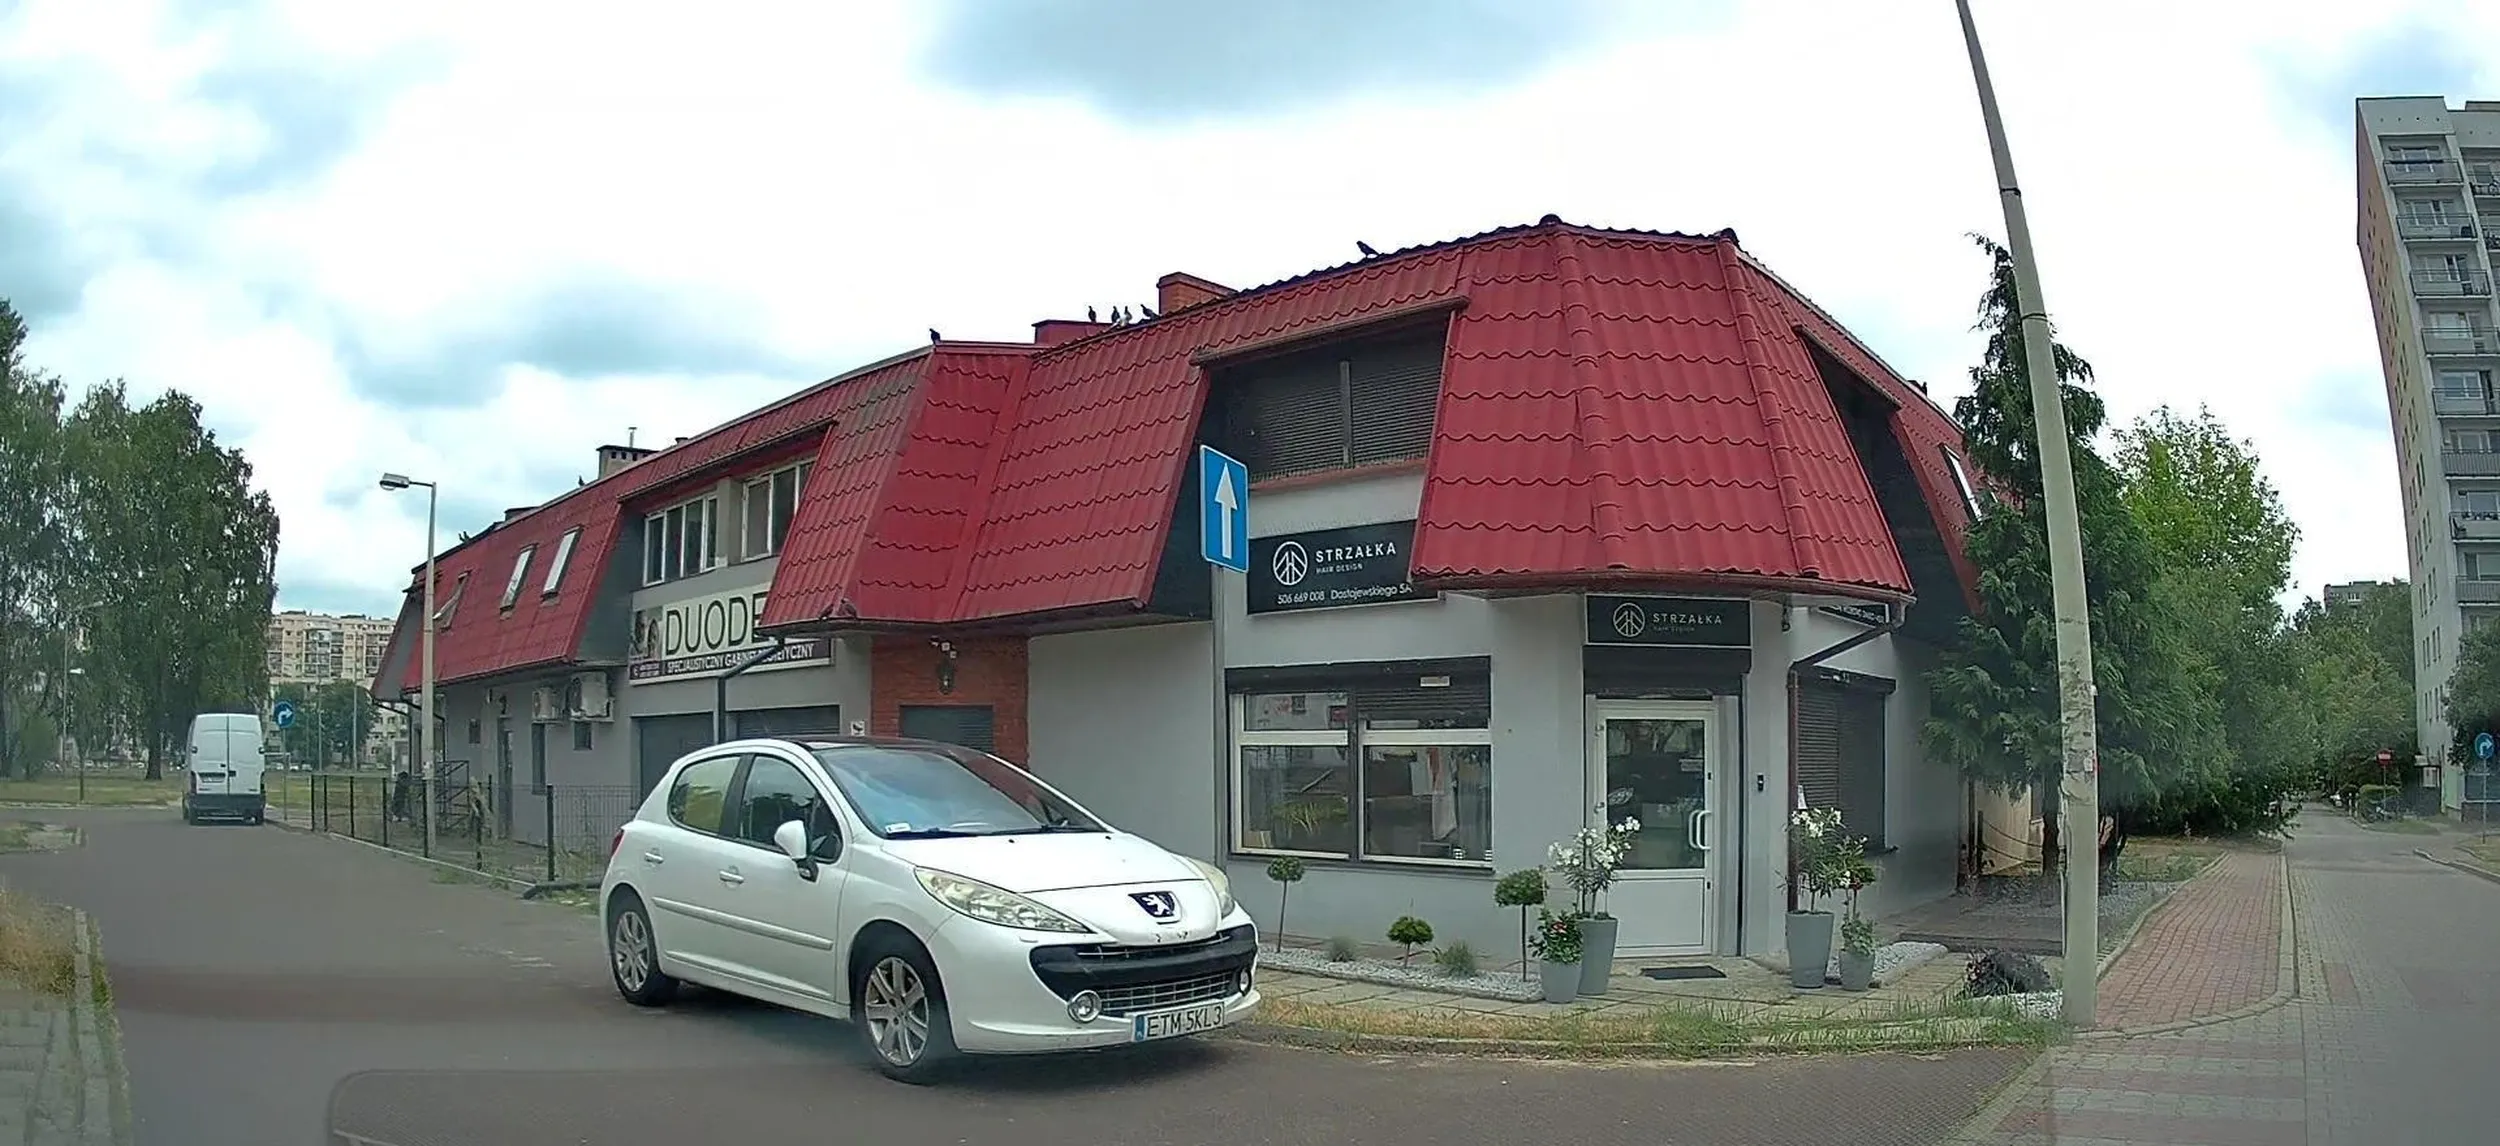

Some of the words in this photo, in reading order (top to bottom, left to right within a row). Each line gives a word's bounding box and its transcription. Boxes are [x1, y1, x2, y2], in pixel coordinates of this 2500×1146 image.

[1315, 542, 1397, 563] STRZAŁKA
[1652, 613, 1723, 625] STRZAŁKA
[1146, 1012, 1182, 1037] ETM
